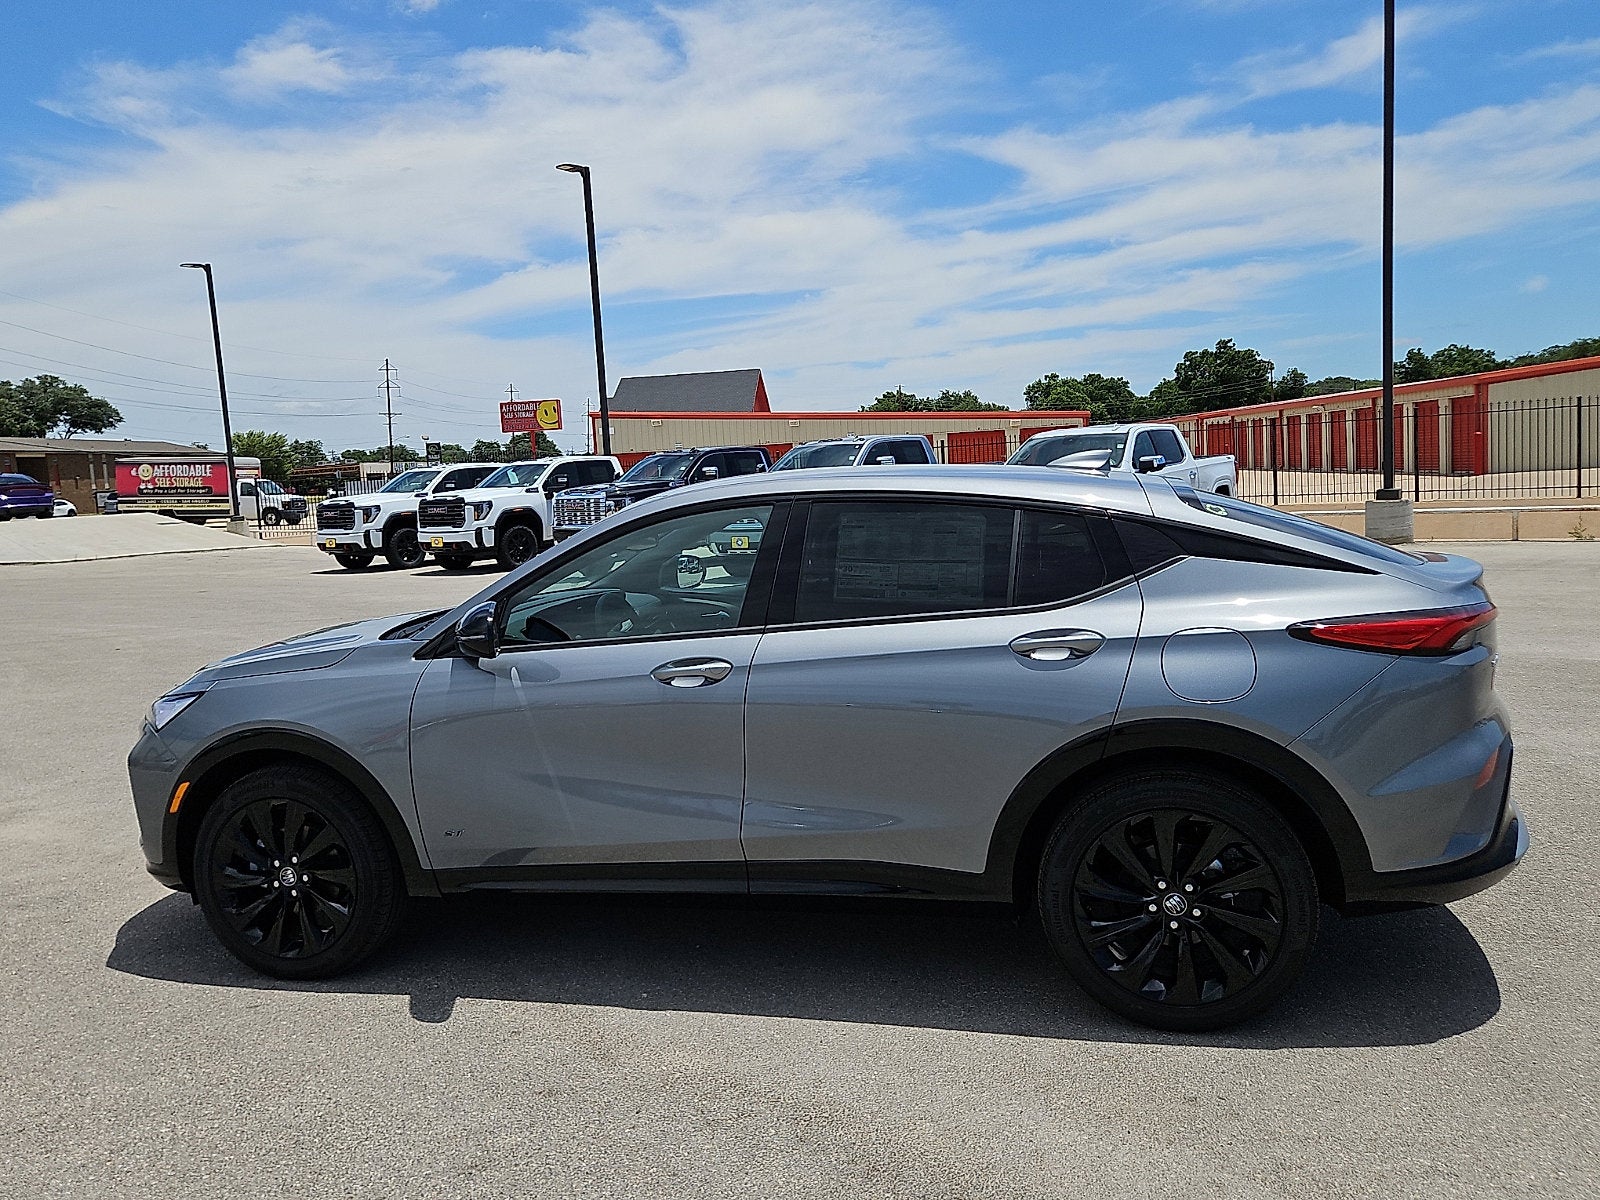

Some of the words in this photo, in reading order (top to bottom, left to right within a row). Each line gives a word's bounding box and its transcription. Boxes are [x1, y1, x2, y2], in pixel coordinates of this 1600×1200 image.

[502, 403, 541, 412] AFFORDABLE
[153, 464, 213, 477] AFFORDABLE
[155, 477, 171, 487] SELF
[171, 477, 203, 487] STORAGE
